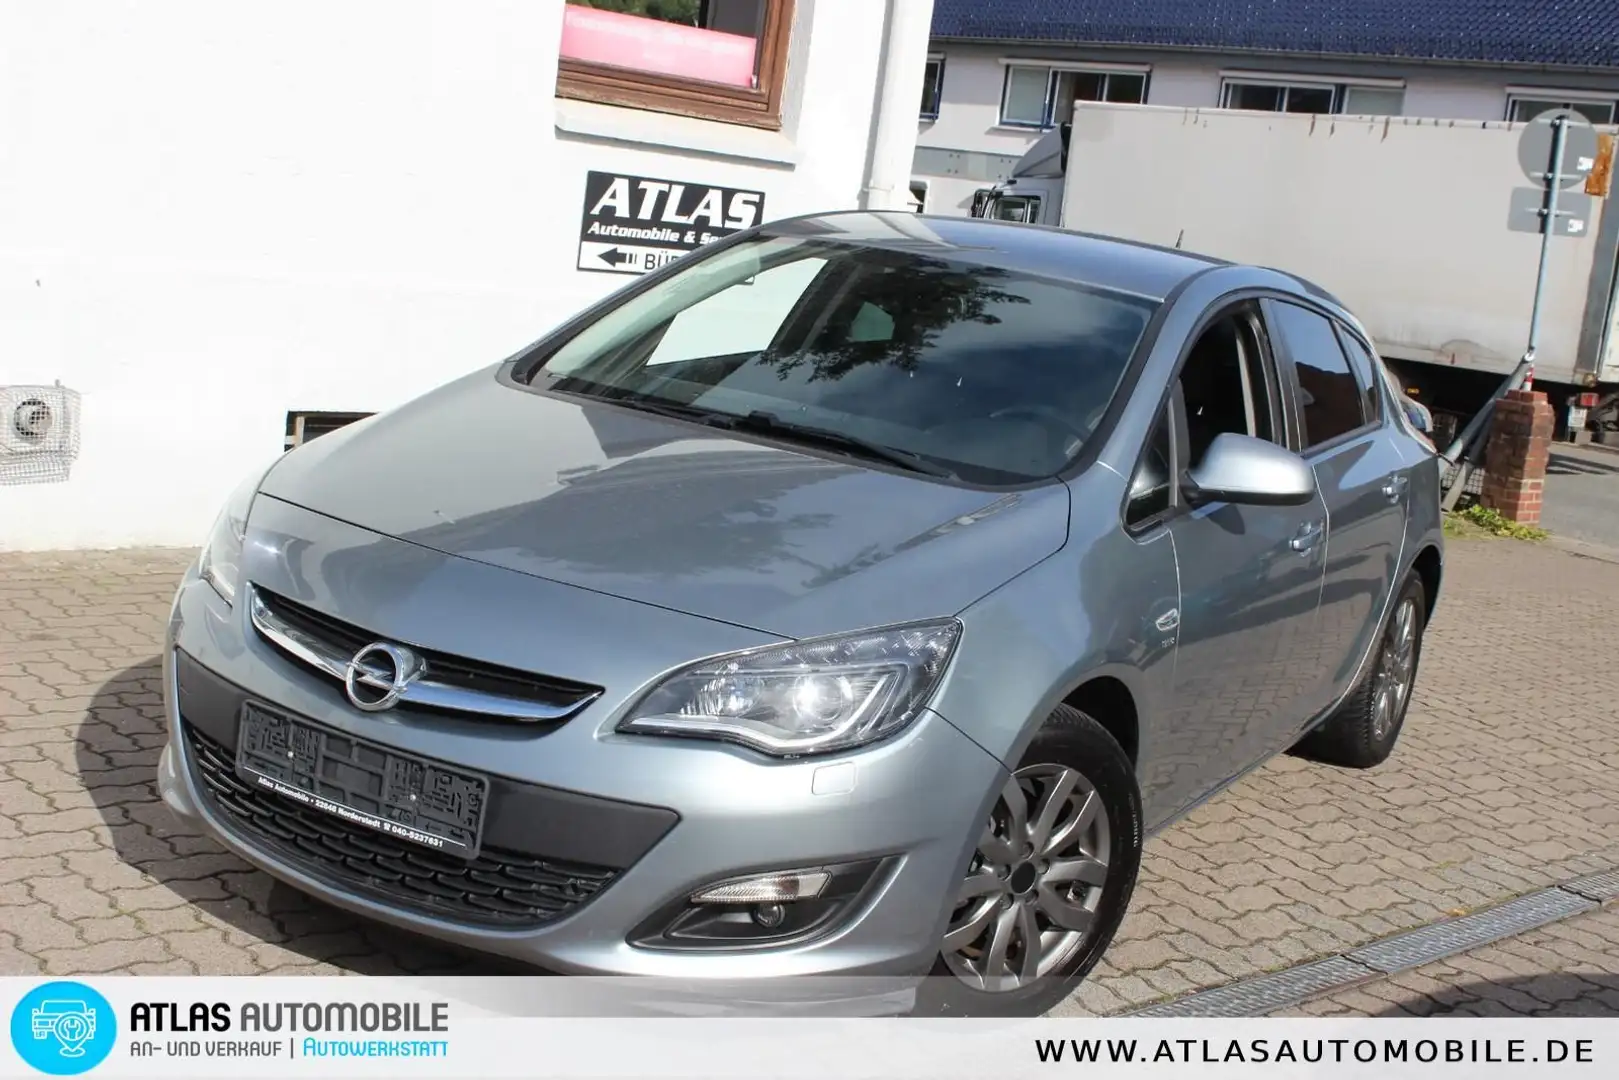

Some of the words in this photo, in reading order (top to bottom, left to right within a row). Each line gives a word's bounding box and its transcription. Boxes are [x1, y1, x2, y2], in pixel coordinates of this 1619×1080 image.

[589, 177, 761, 230] ATLAS
[588, 221, 680, 242] Automobile
[683, 231, 697, 244] &
[699, 232, 725, 245] Se
[275, 784, 310, 803] Automobile
[338, 804, 381, 829] Norderstedt
